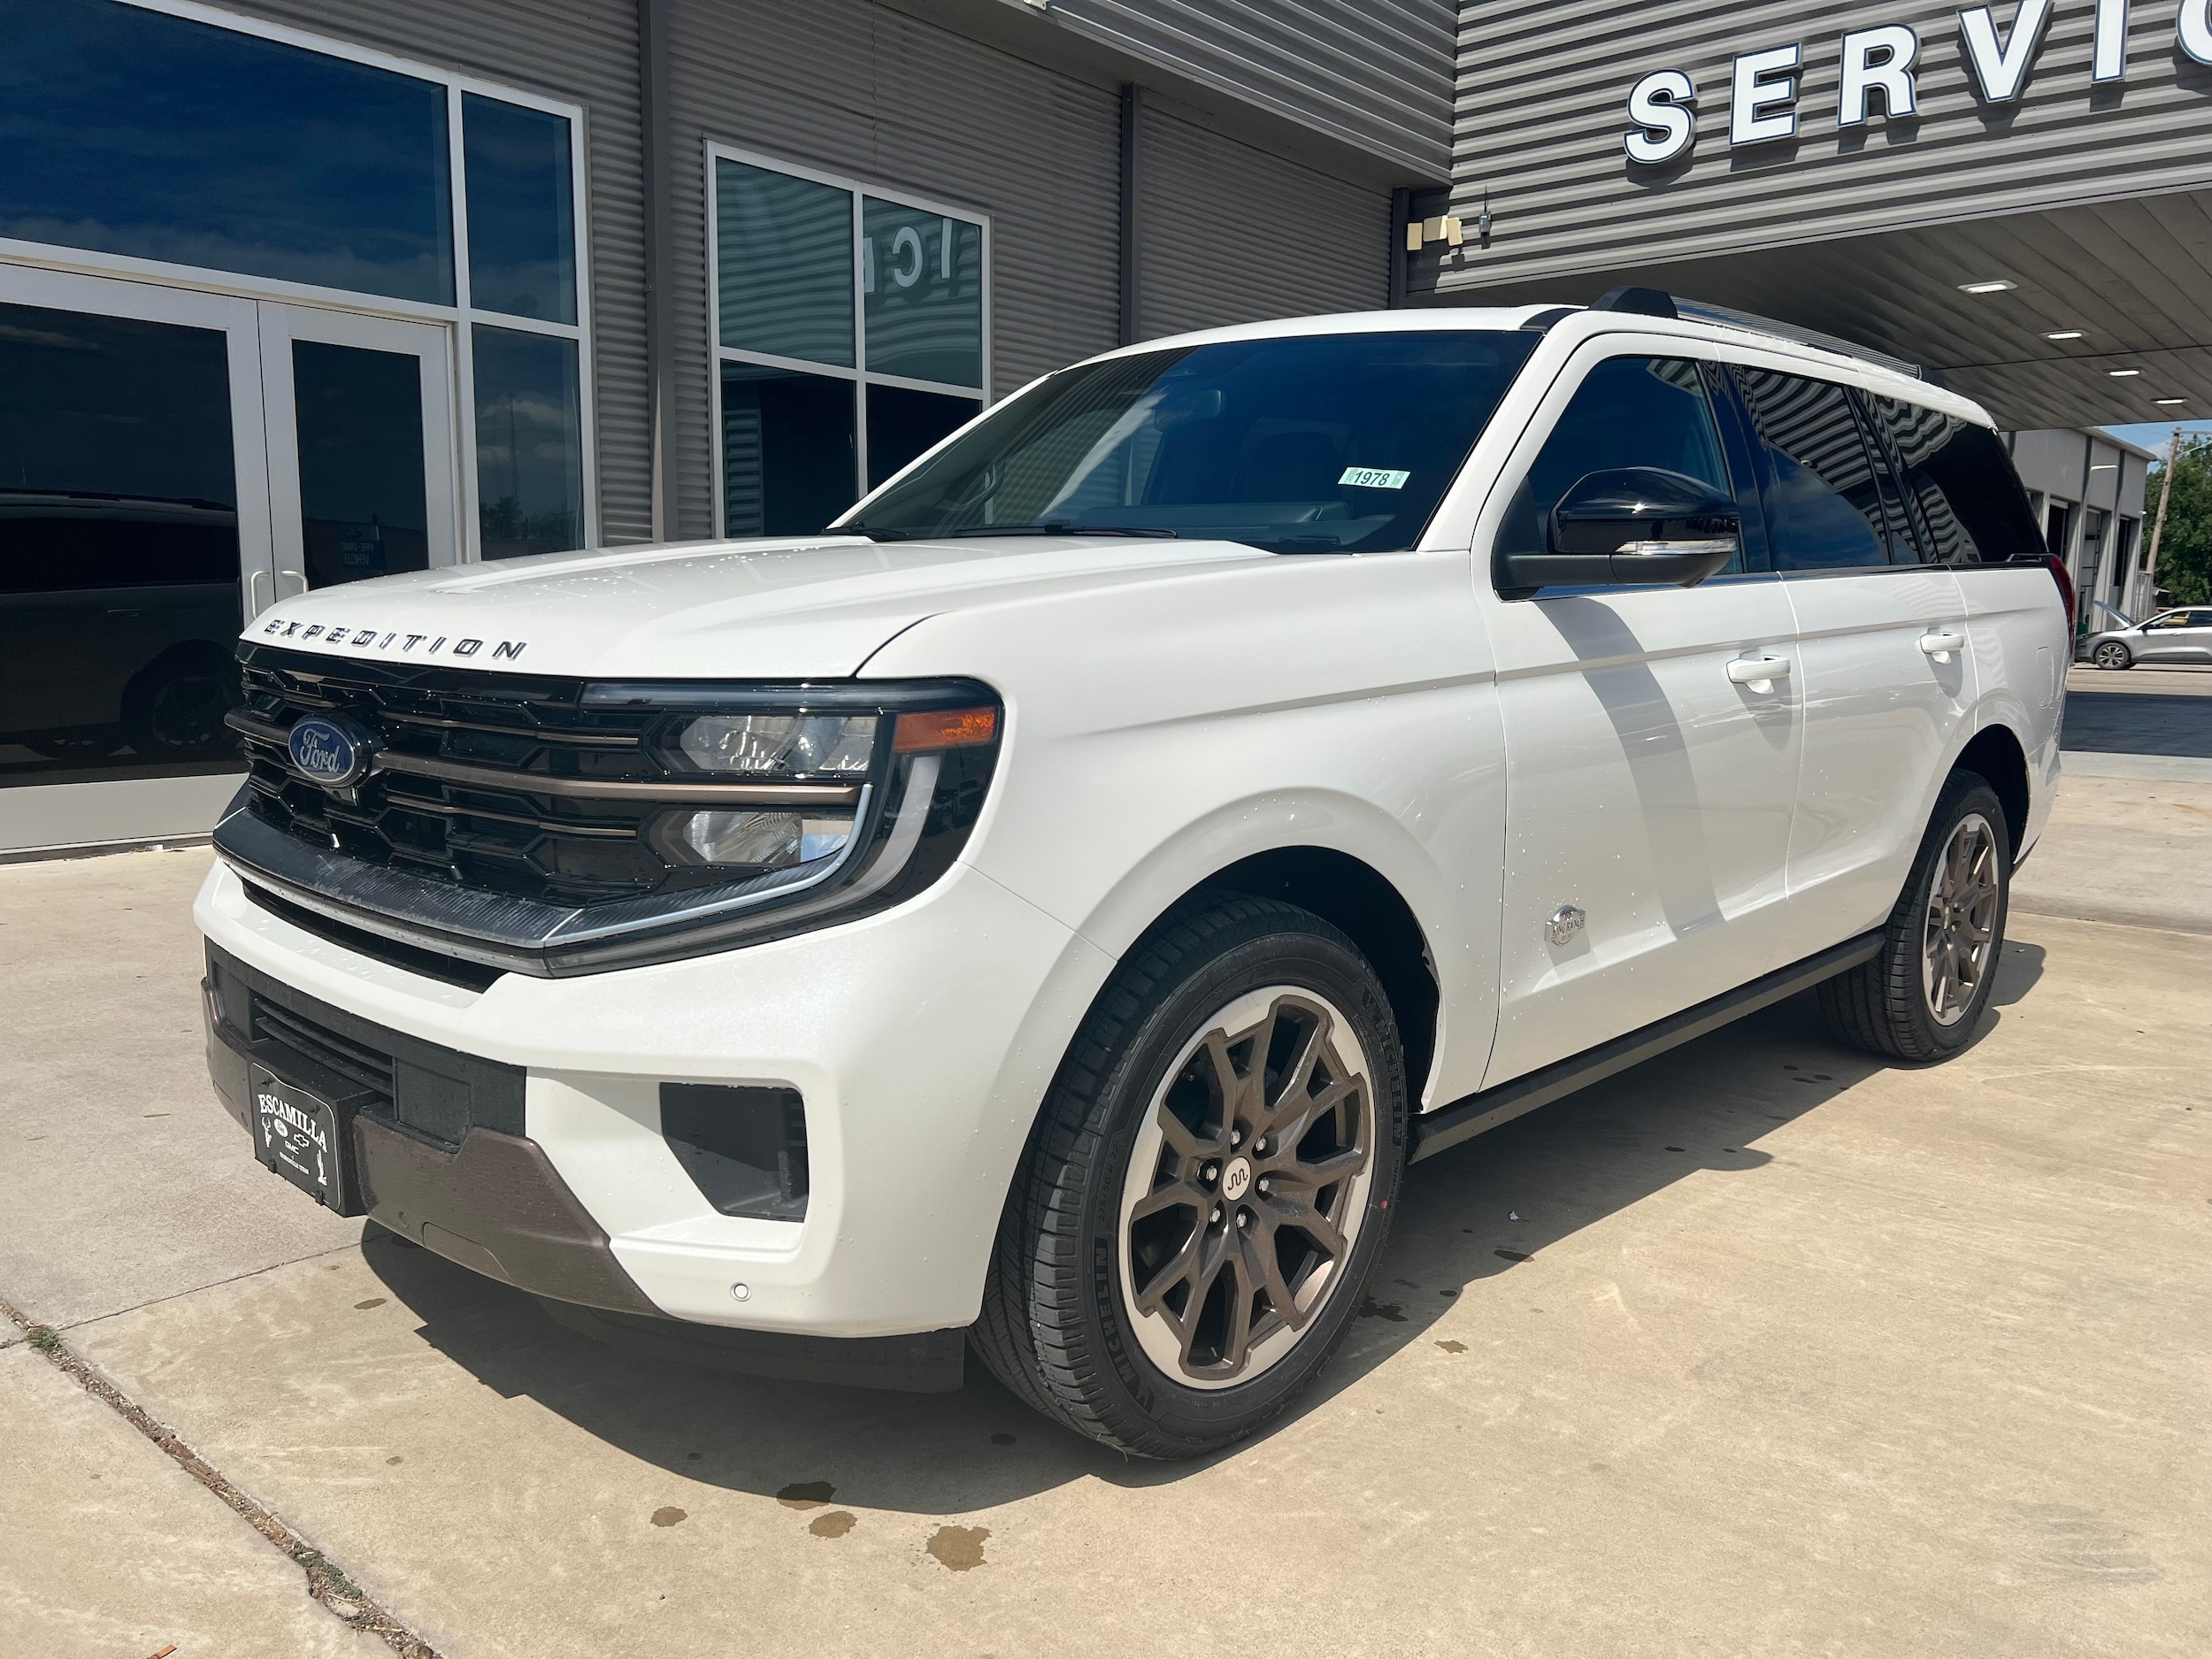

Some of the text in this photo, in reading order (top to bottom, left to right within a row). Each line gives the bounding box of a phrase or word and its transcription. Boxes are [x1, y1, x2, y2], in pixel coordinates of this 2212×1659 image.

[1623, 0, 2212, 165] SERVI
[1354, 471, 1390, 486] 1978
[264, 618, 528, 661] EXPEDITION
[299, 728, 341, 773] Ford
[1376, 1019, 1402, 1138] MICHELIN
[257, 1094, 327, 1154] ESCAMILLA
[285, 1140, 300, 1156] GMC
[1098, 1144, 1119, 1223] 275/50 R 22
[1095, 1248, 1137, 1384] MICHELIN
